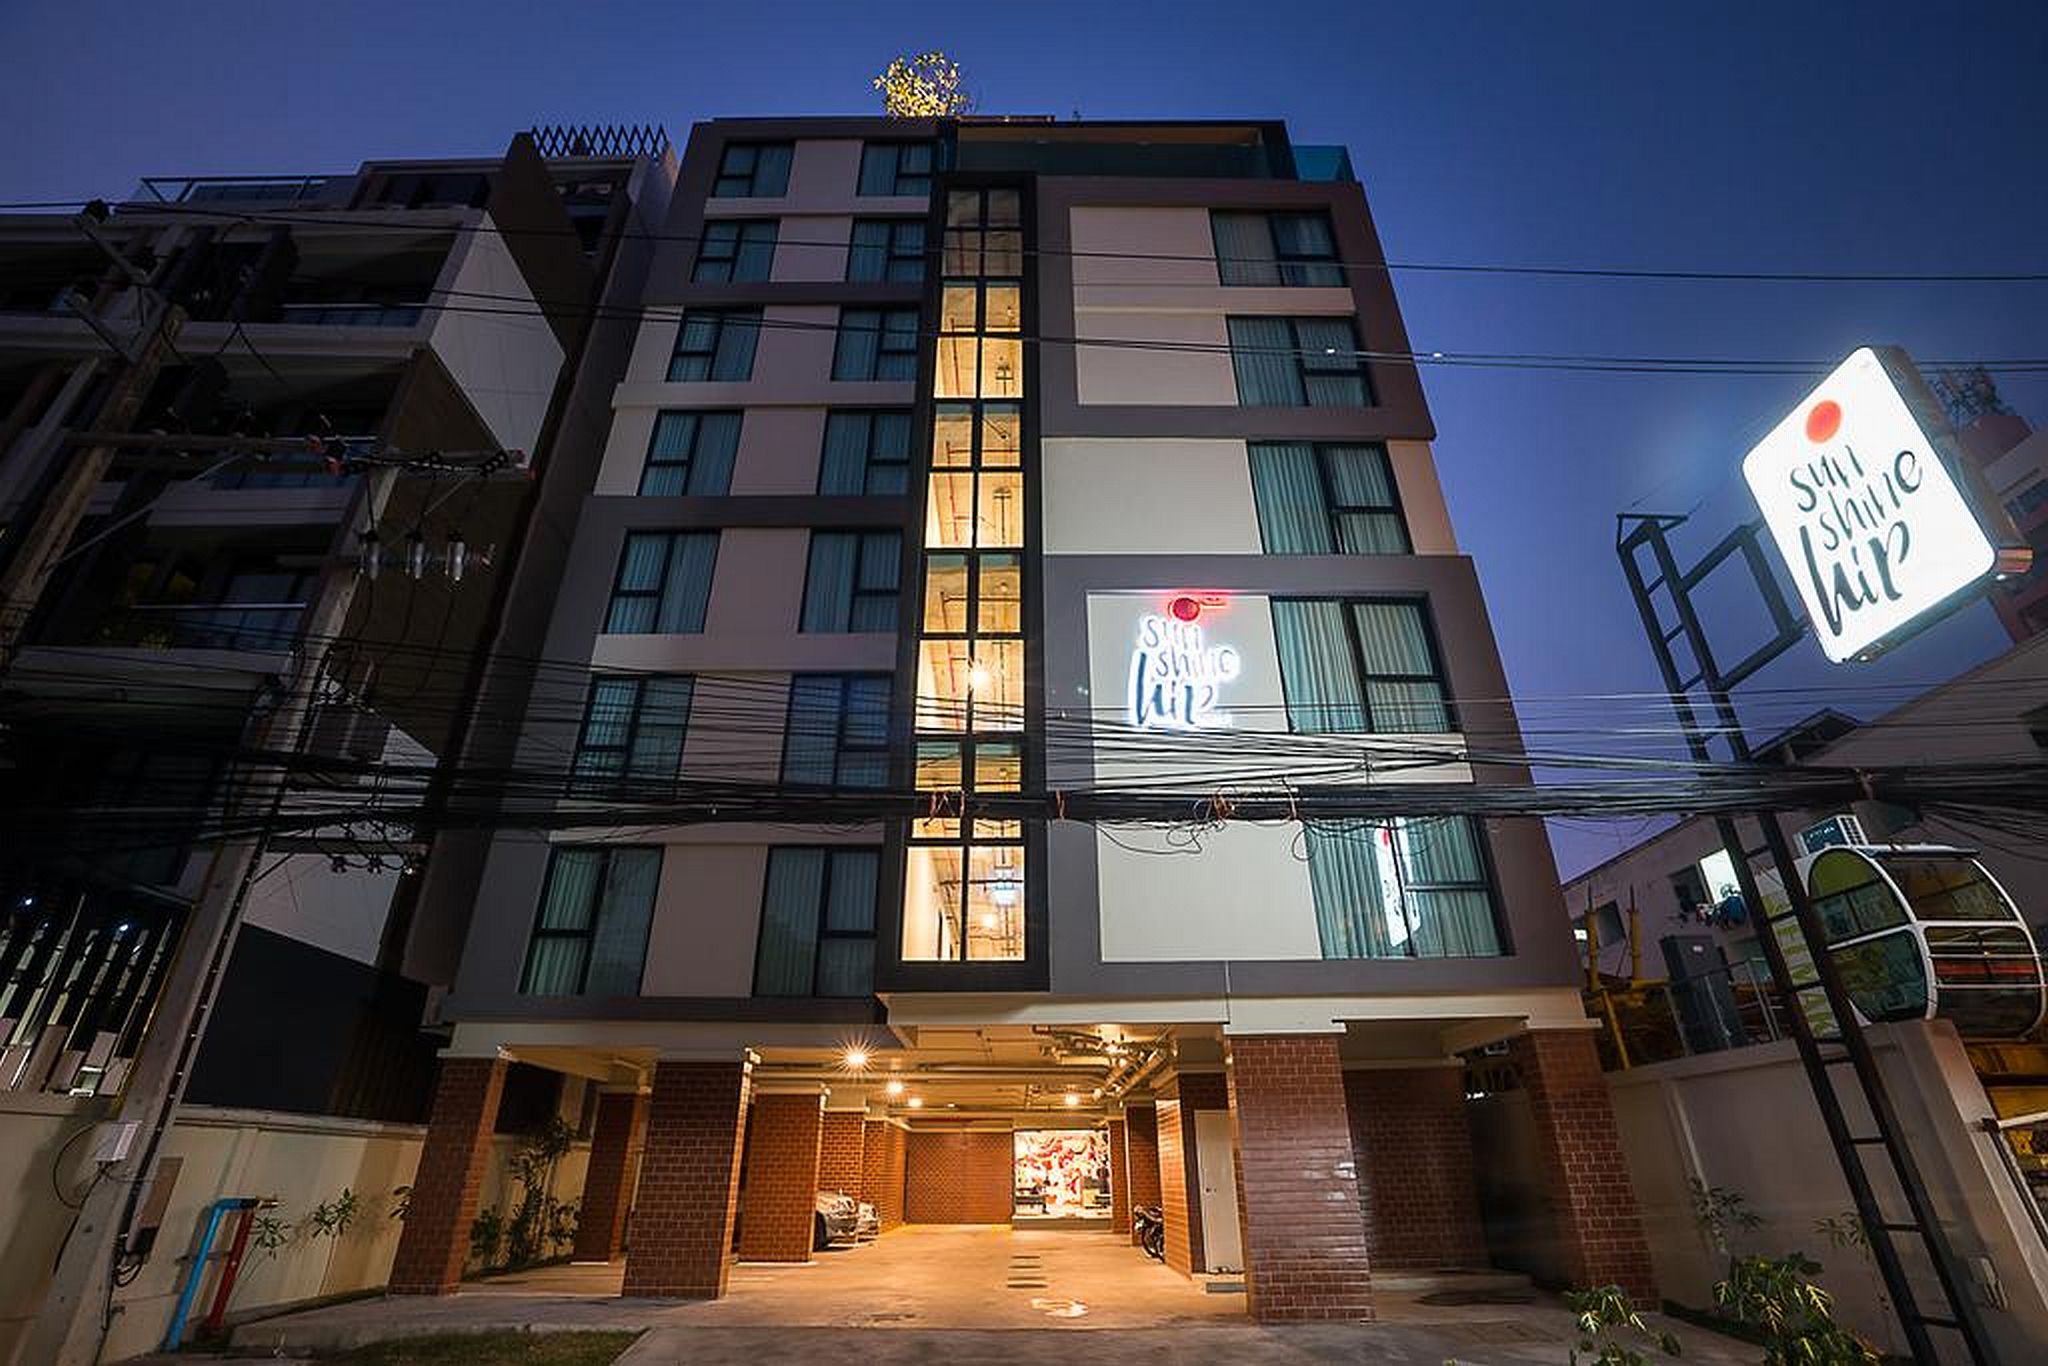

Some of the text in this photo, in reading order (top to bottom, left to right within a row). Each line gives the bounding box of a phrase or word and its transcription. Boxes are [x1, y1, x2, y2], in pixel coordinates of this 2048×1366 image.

[1790, 444, 1864, 512] sun
[1820, 450, 1923, 550] shine
[1800, 520, 1910, 636] hip
[1134, 651, 1214, 726] hip
